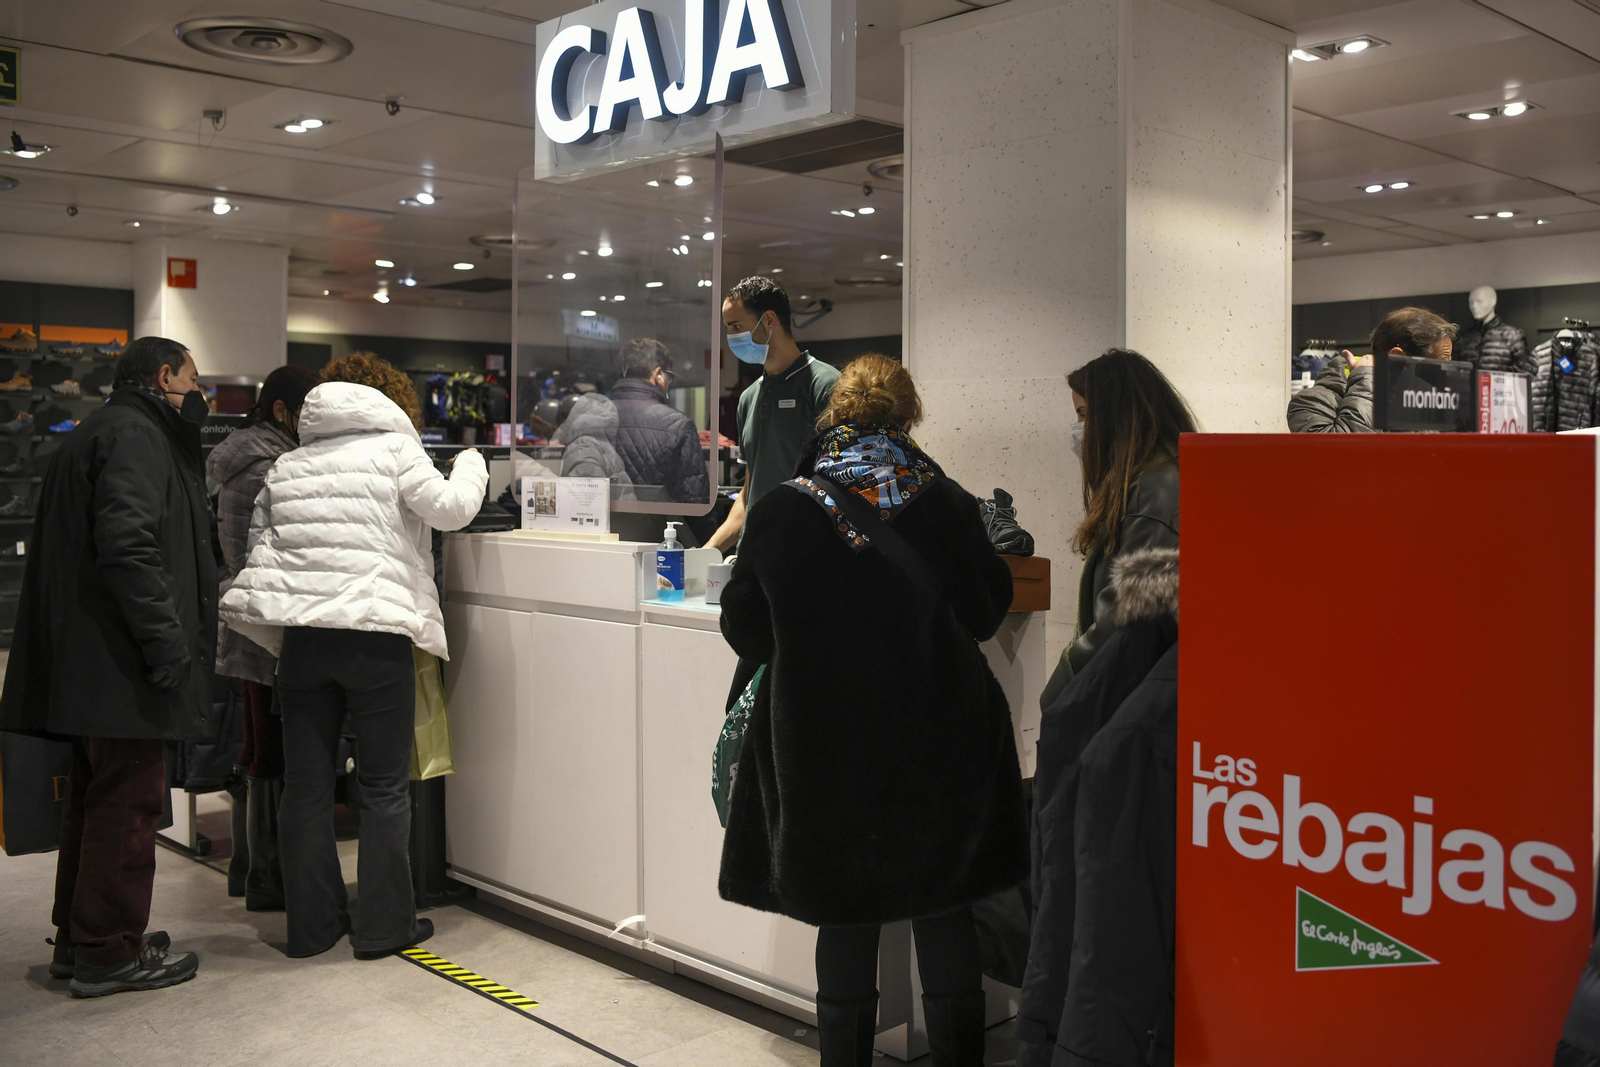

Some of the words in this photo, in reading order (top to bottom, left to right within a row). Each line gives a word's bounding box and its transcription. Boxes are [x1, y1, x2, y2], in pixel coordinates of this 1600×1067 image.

[536, 0, 790, 144] CAJA
[1192, 741, 1257, 786] Las
[1192, 774, 1577, 922] rebajas
[1302, 920, 1316, 938] El
[1316, 925, 1350, 947] Corte
